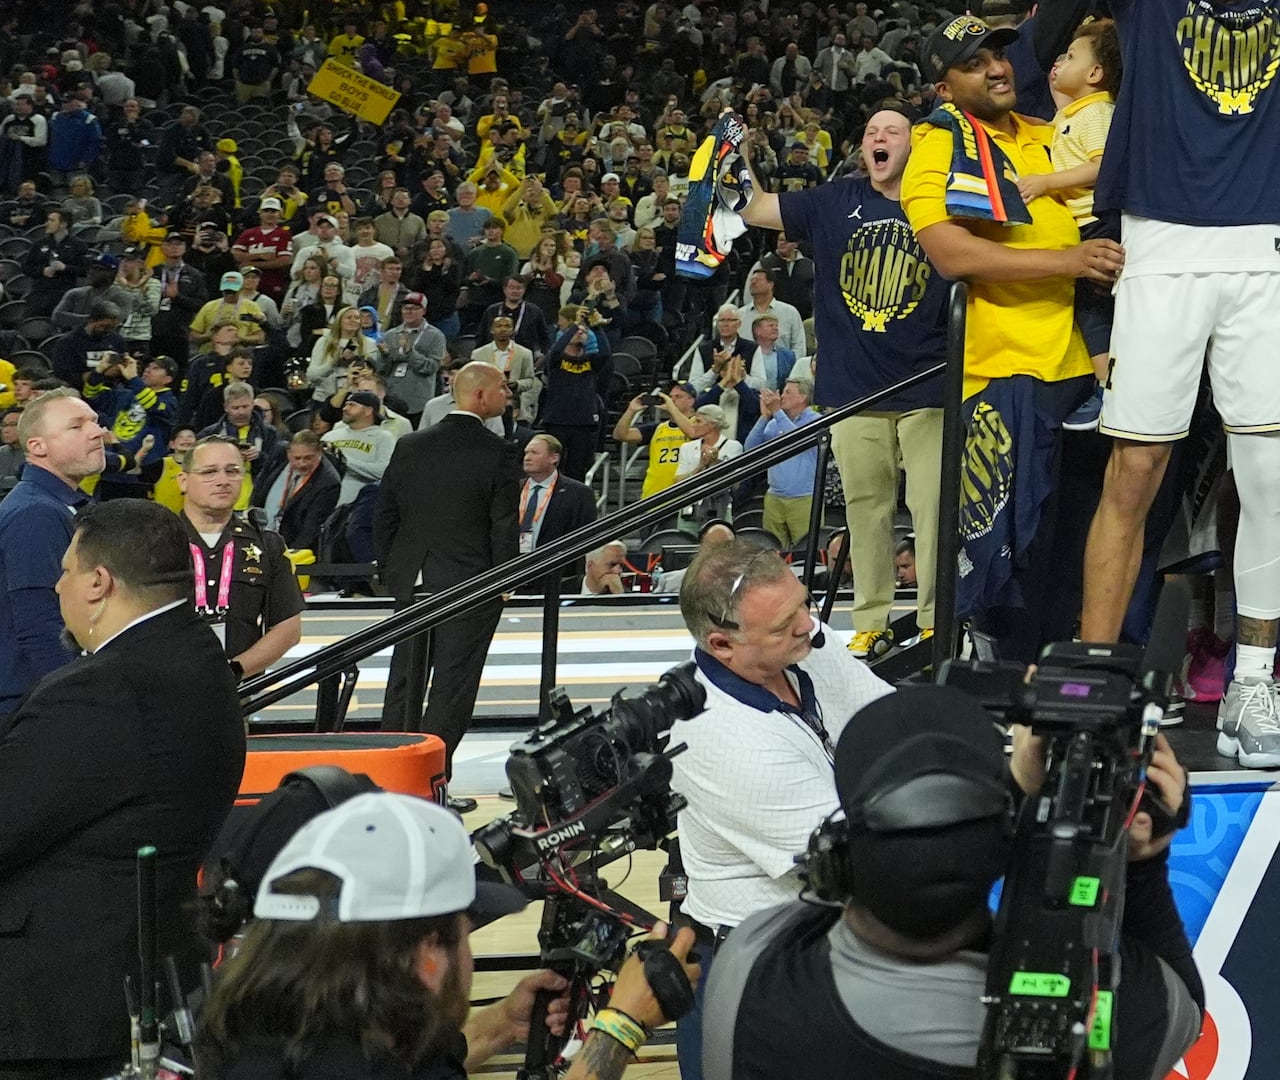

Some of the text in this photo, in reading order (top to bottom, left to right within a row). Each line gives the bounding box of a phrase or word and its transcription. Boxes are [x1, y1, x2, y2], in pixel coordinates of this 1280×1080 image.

[326, 62, 396, 102] SHOCK THE WORLD
[339, 82, 369, 103] BOYS
[328, 90, 343, 103] GO
[1217, 91, 1255, 115] M
[840, 244, 932, 310] CHAMPS
[862, 310, 887, 333] M
[658, 447, 680, 464] 23
[537, 821, 586, 851] RONIN
